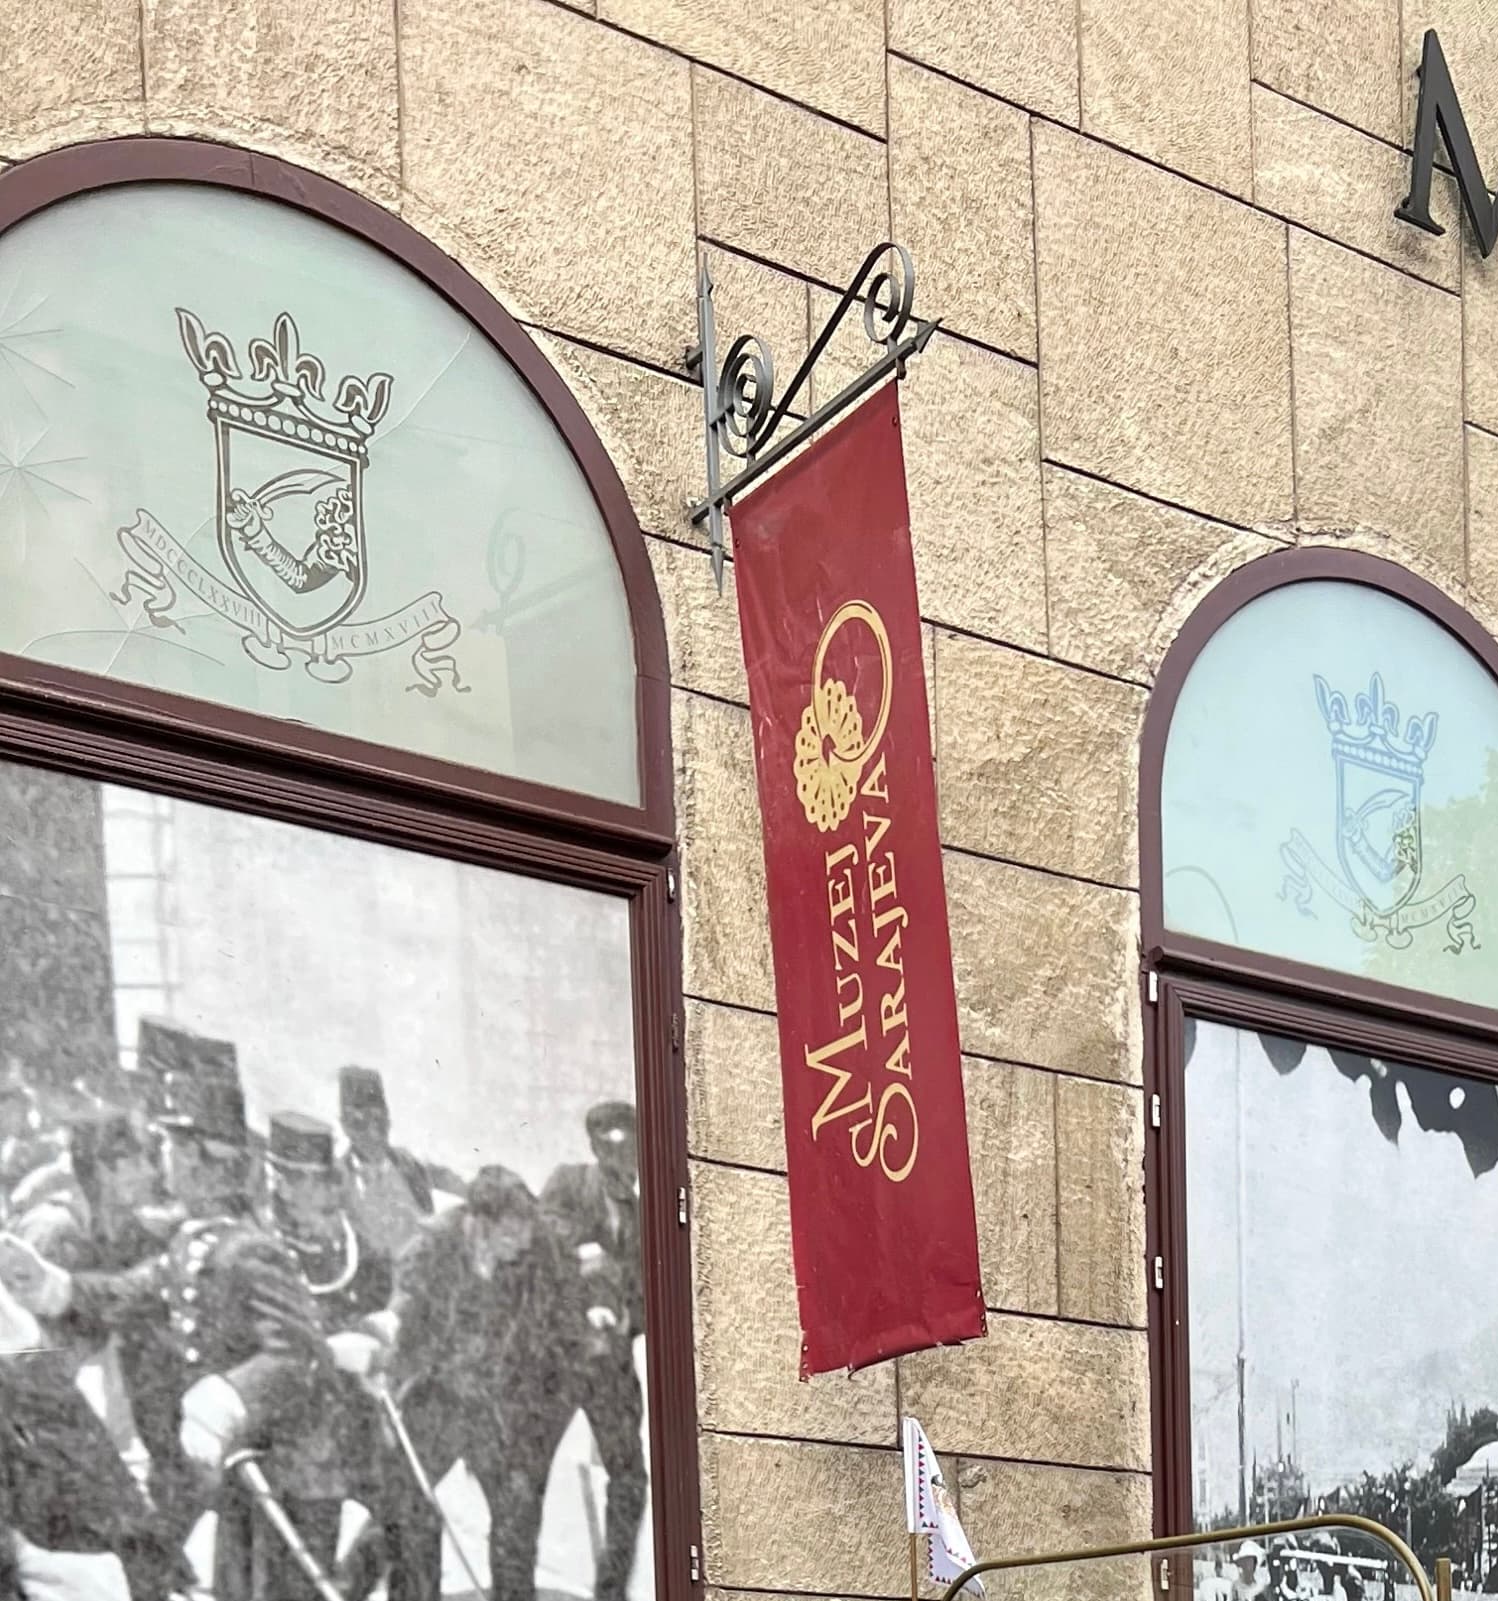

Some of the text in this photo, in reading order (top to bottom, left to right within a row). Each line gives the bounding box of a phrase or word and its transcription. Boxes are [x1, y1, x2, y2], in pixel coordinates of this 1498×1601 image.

[330, 601, 439, 650] MCMXVIII
[804, 844, 872, 1141] MUZEJ
[850, 752, 919, 1182] SARAJEVA
